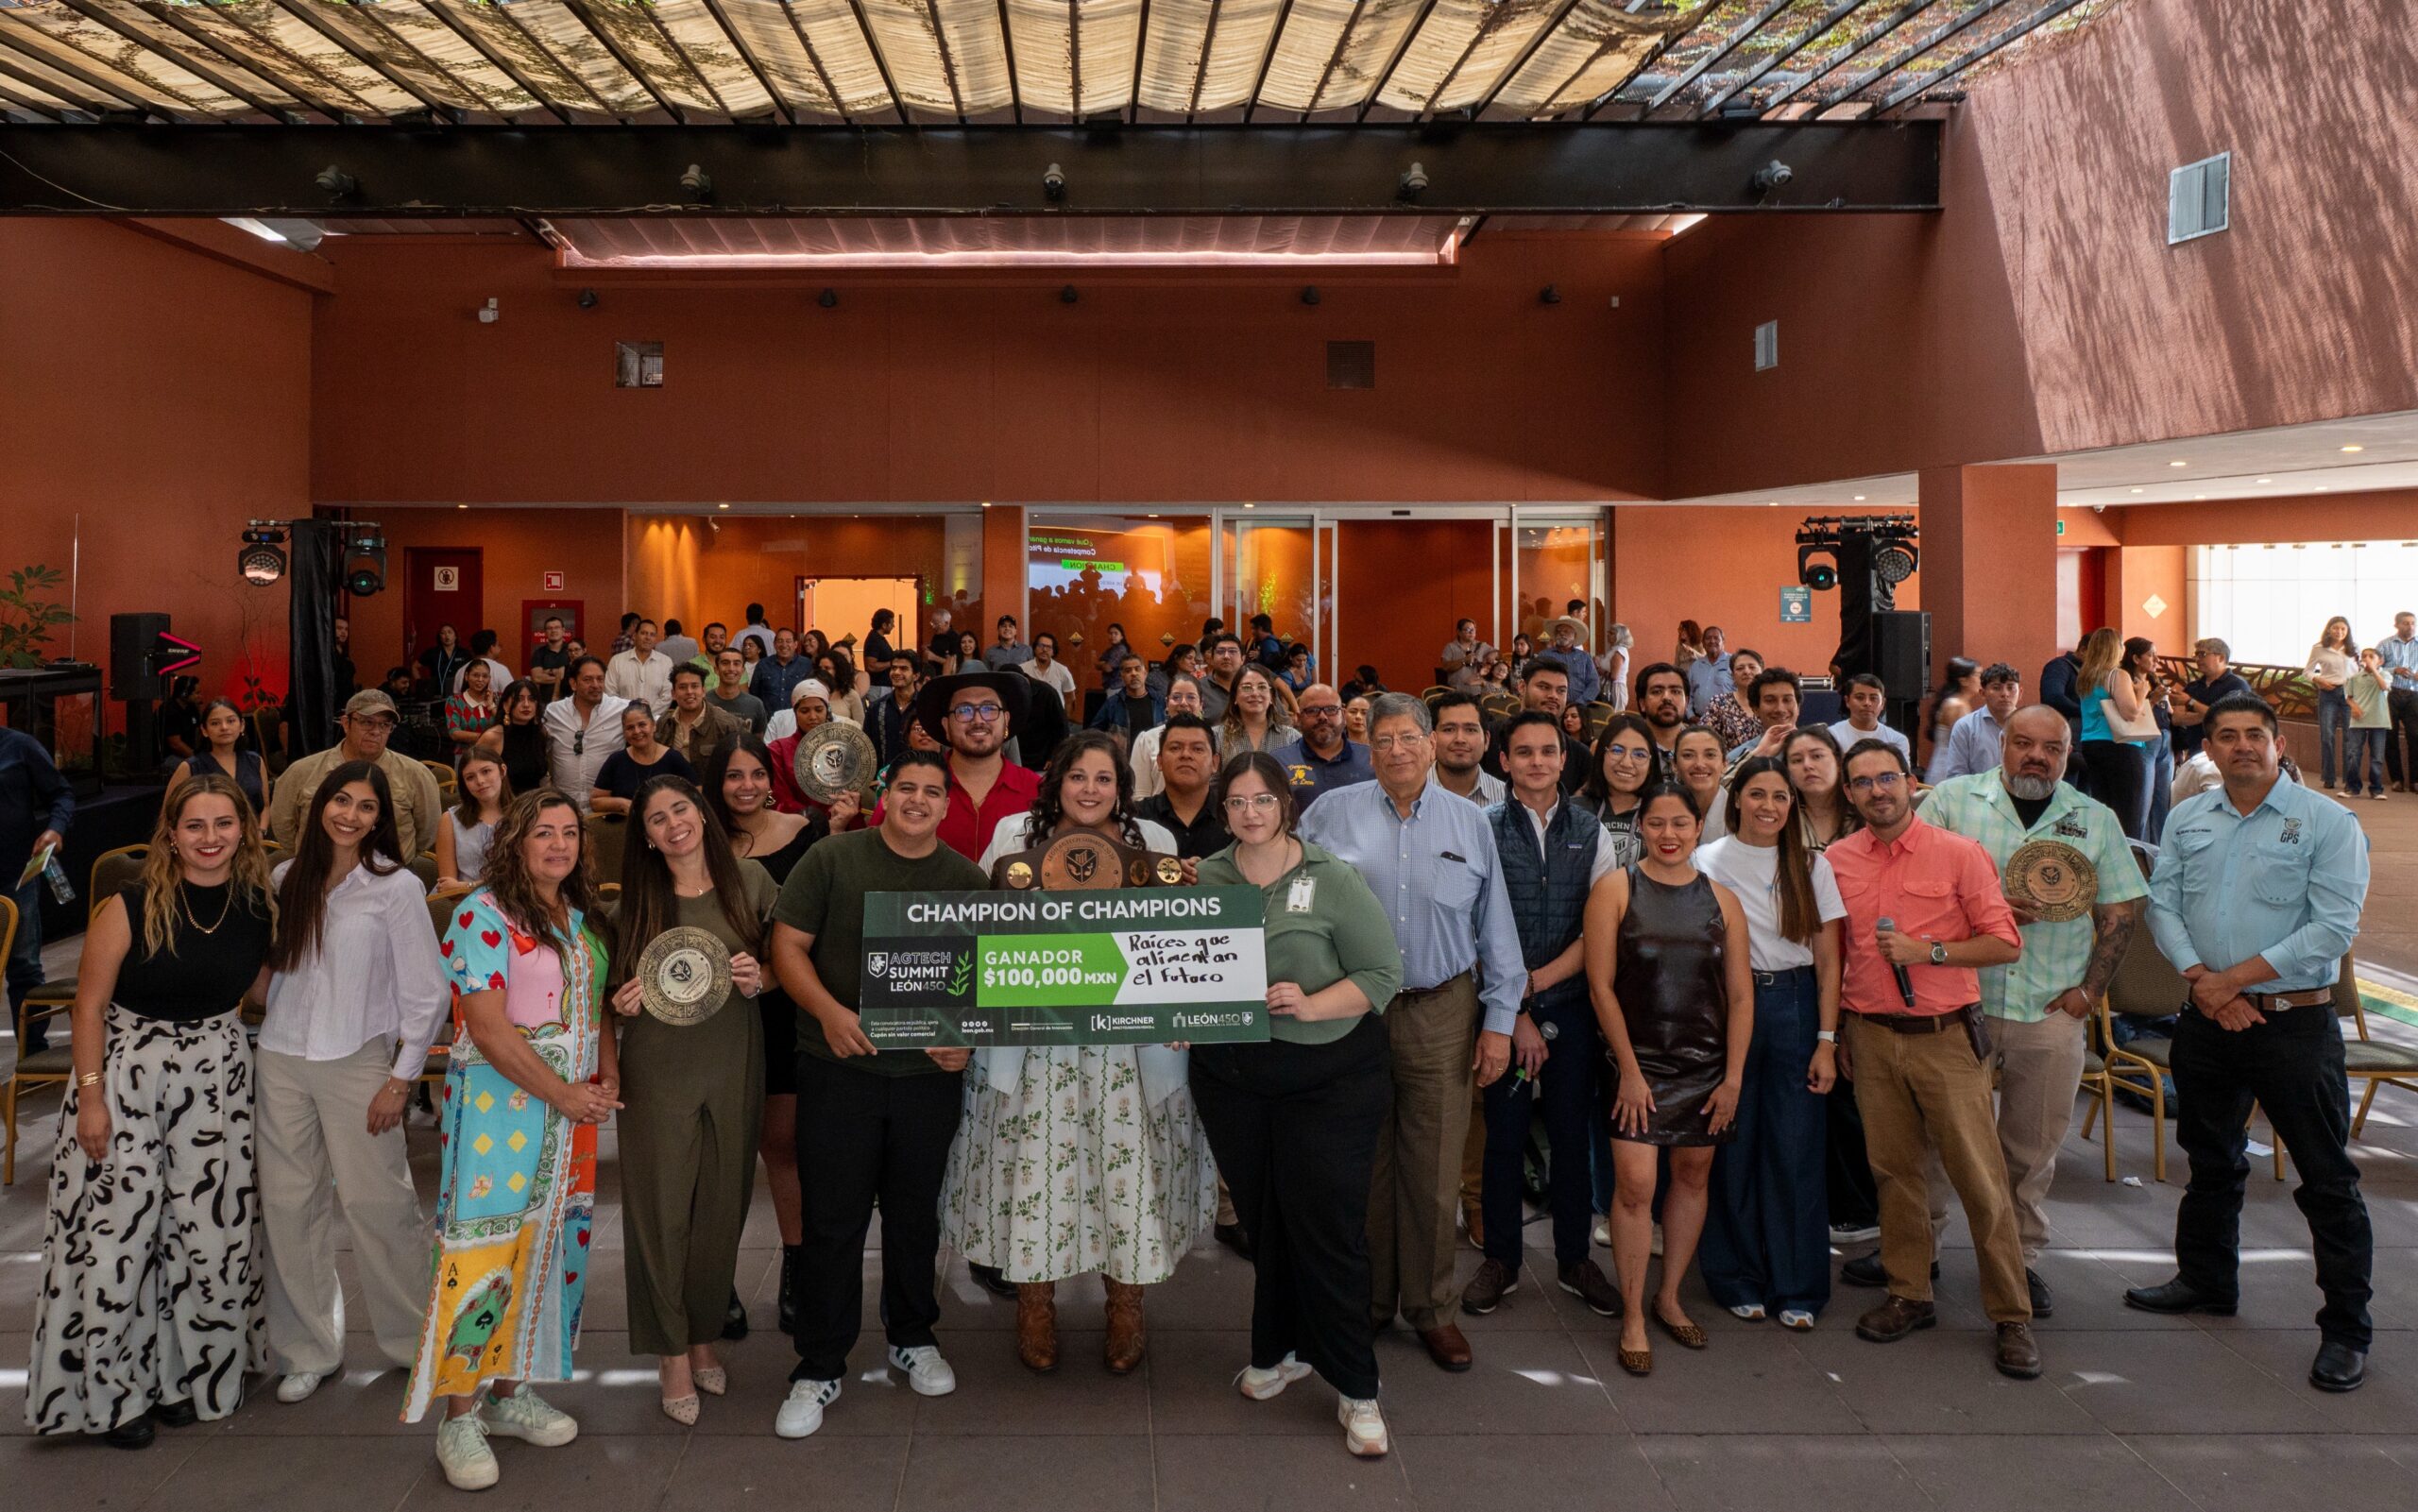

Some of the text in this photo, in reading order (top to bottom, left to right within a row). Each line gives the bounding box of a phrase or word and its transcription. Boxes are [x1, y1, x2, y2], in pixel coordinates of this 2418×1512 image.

[2280, 832, 2300, 845] GPS
[907, 896, 1221, 923] CHAMPION OF CHAMPIONS
[1129, 934, 1231, 956] Raíces que
[890, 951, 951, 964] AGTECH
[984, 950, 1083, 965] GANADOR
[889, 966, 949, 978] SUMMIT
[983, 967, 1117, 989] $100,000 MXN
[1132, 968, 1153, 986] el
[1112, 1016, 1154, 1026] KIRCHNER
[448, 1262, 458, 1276] A
